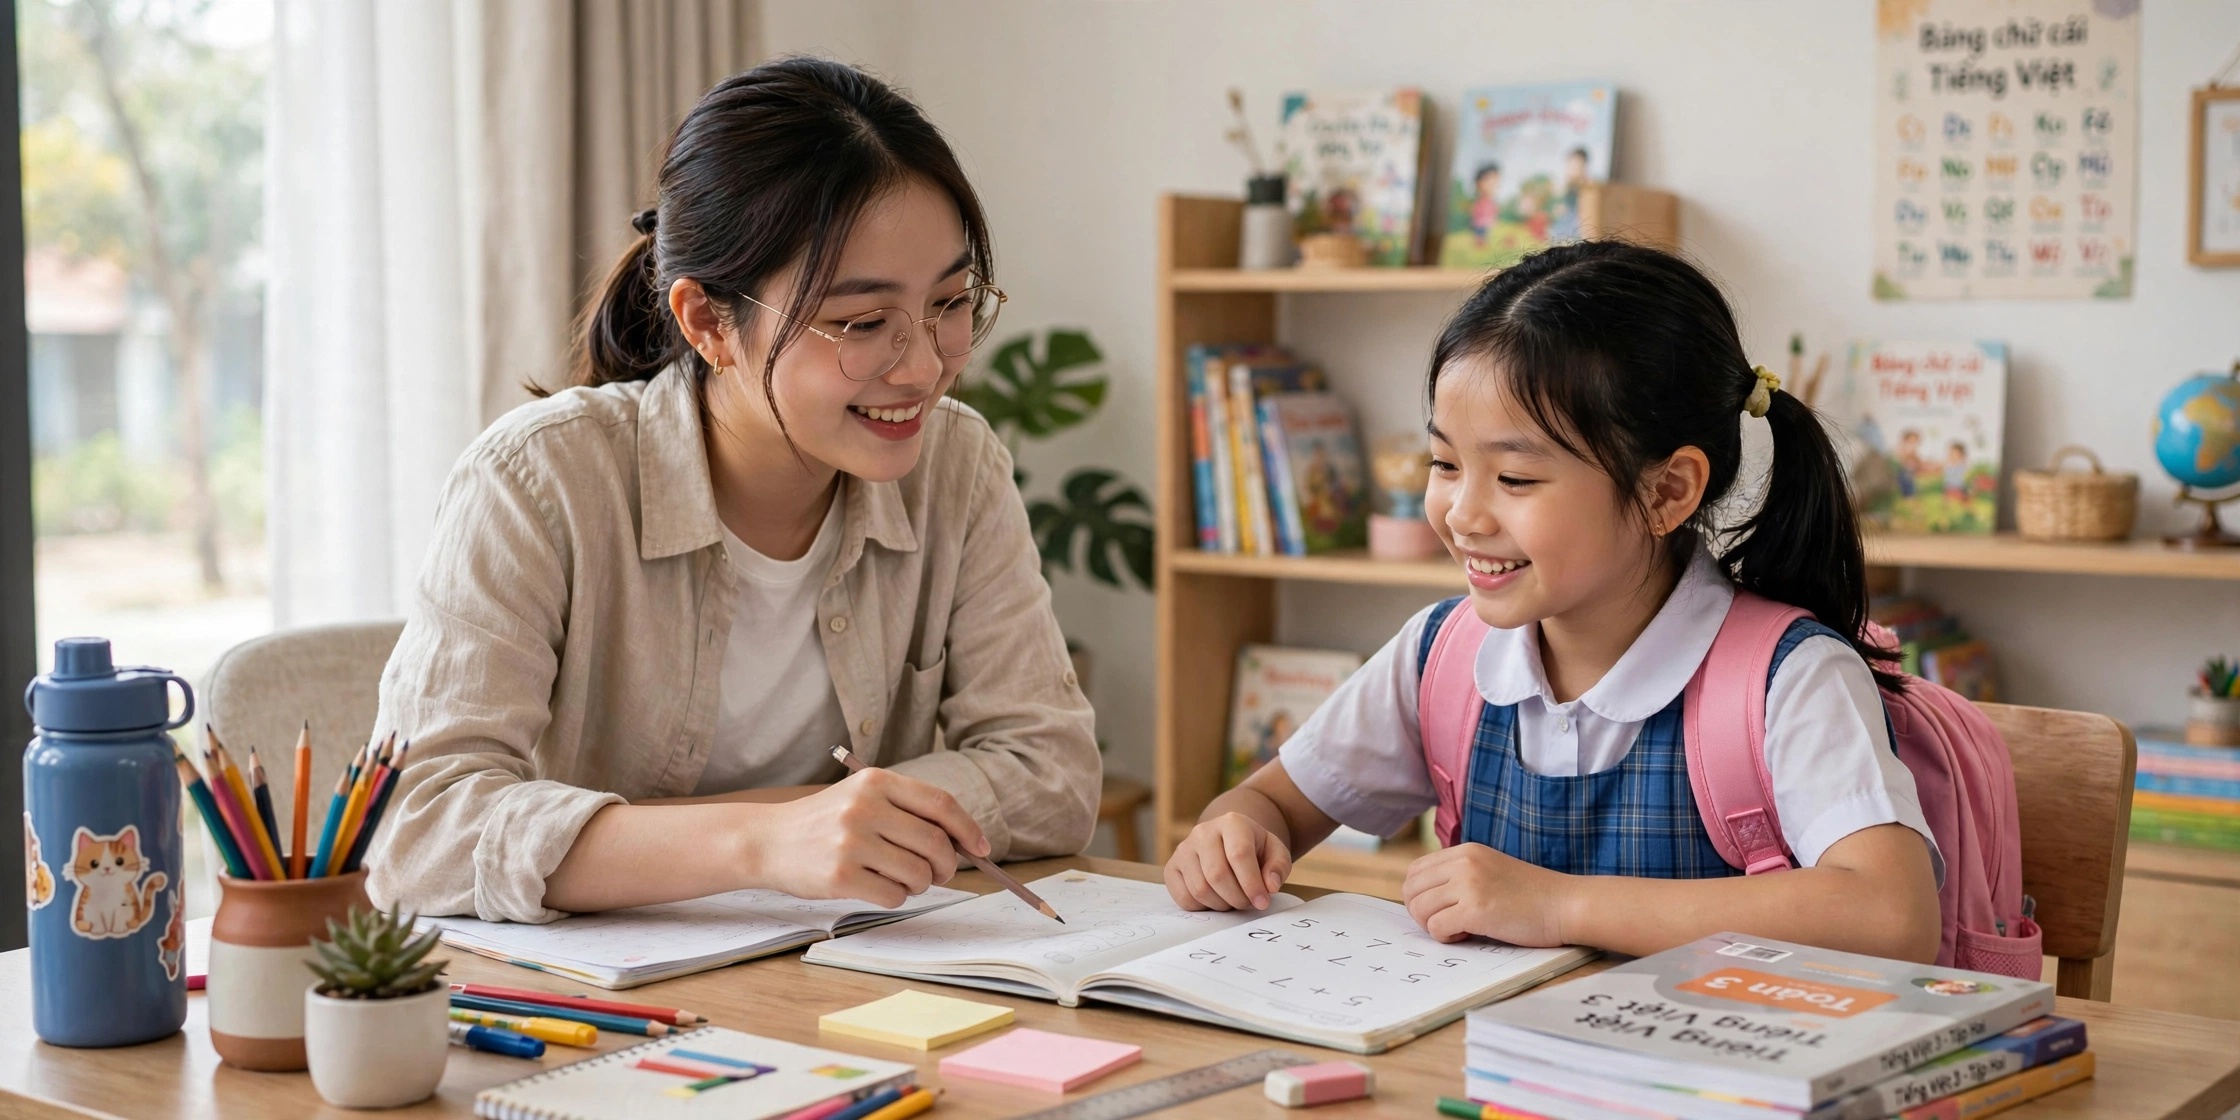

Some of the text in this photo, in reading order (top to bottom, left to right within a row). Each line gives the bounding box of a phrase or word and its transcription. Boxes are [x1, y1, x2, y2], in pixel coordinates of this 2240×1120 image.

[1247, 927, 1283, 944] 12
[1188, 948, 1227, 966] 12
[1327, 955, 1352, 967] 7
[1268, 977, 1294, 988] 7
[1400, 972, 1431, 985] 5
[1703, 975, 1744, 990] 3
[1341, 995, 1373, 1008] 5
[1579, 993, 1614, 1007] 3
